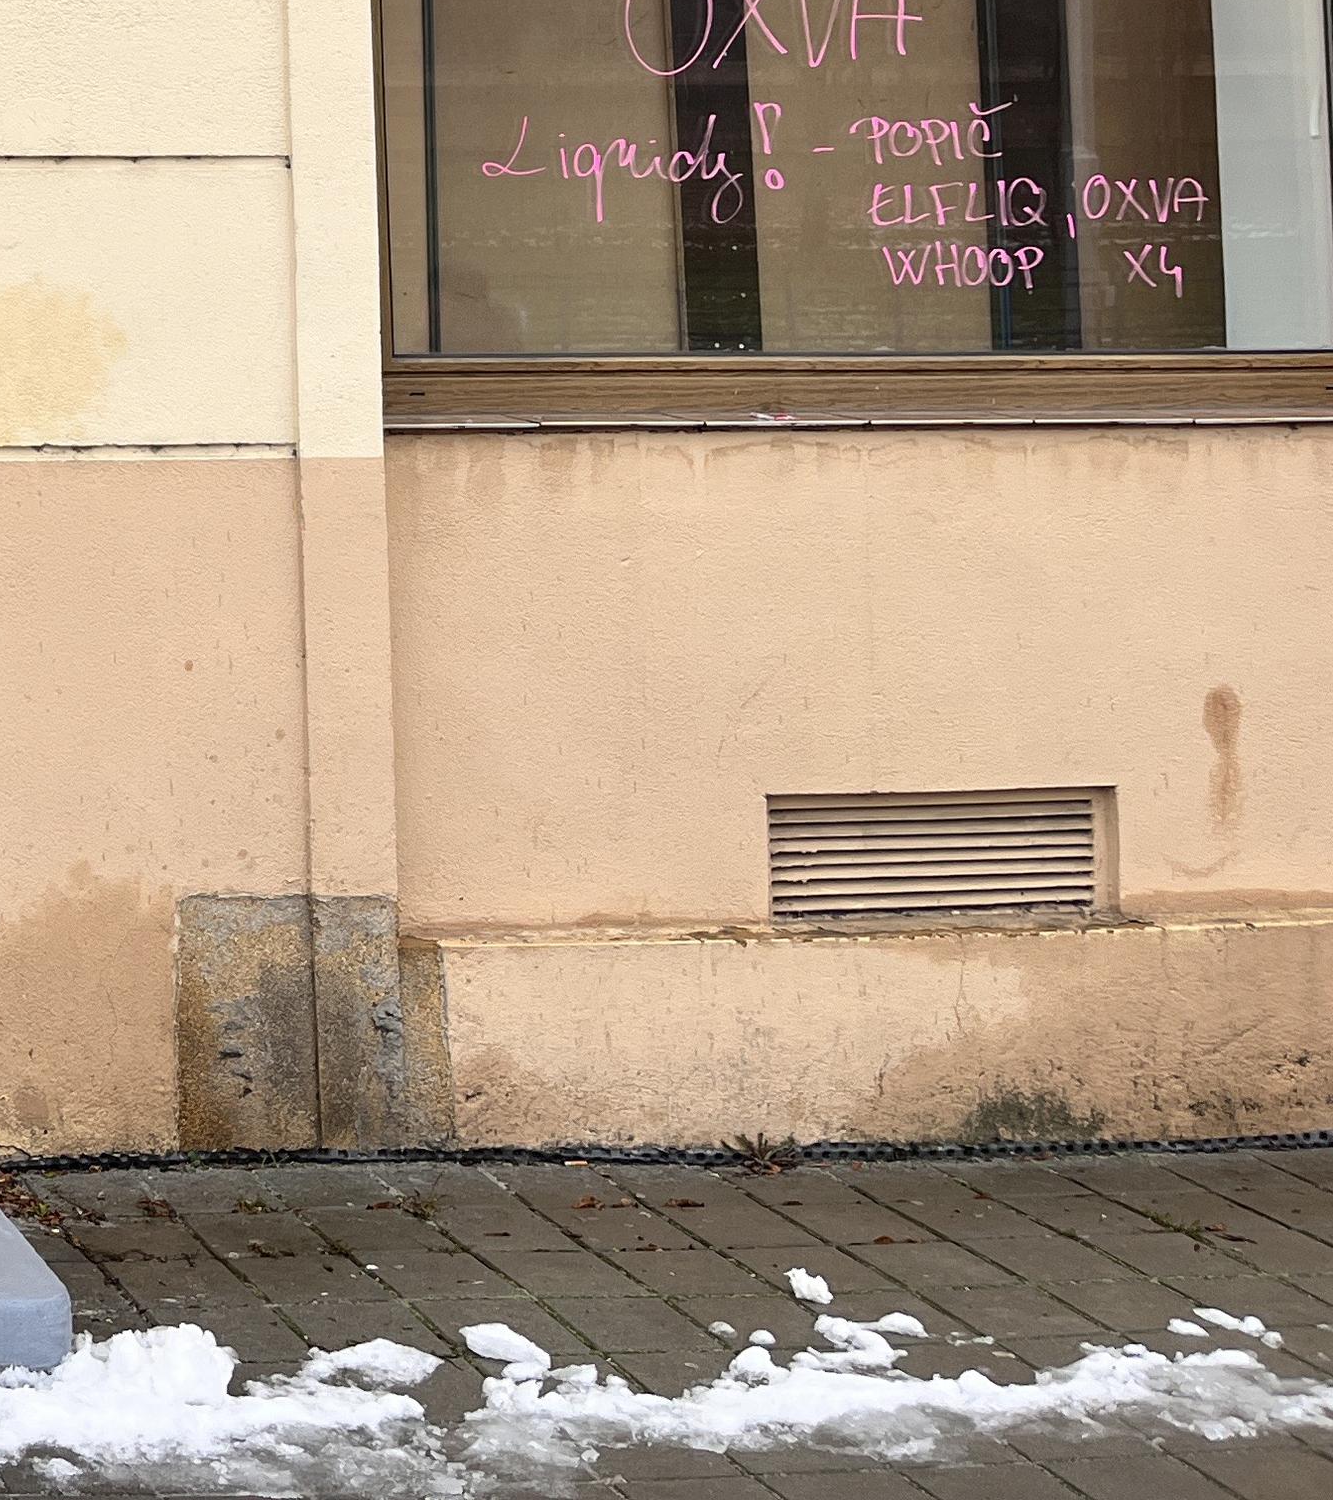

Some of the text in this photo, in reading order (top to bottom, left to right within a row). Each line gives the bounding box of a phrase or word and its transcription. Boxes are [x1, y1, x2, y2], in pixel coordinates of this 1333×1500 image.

[849, 100, 1016, 166] POPIČ
[881, 240, 1184, 299] WHOOP X4
